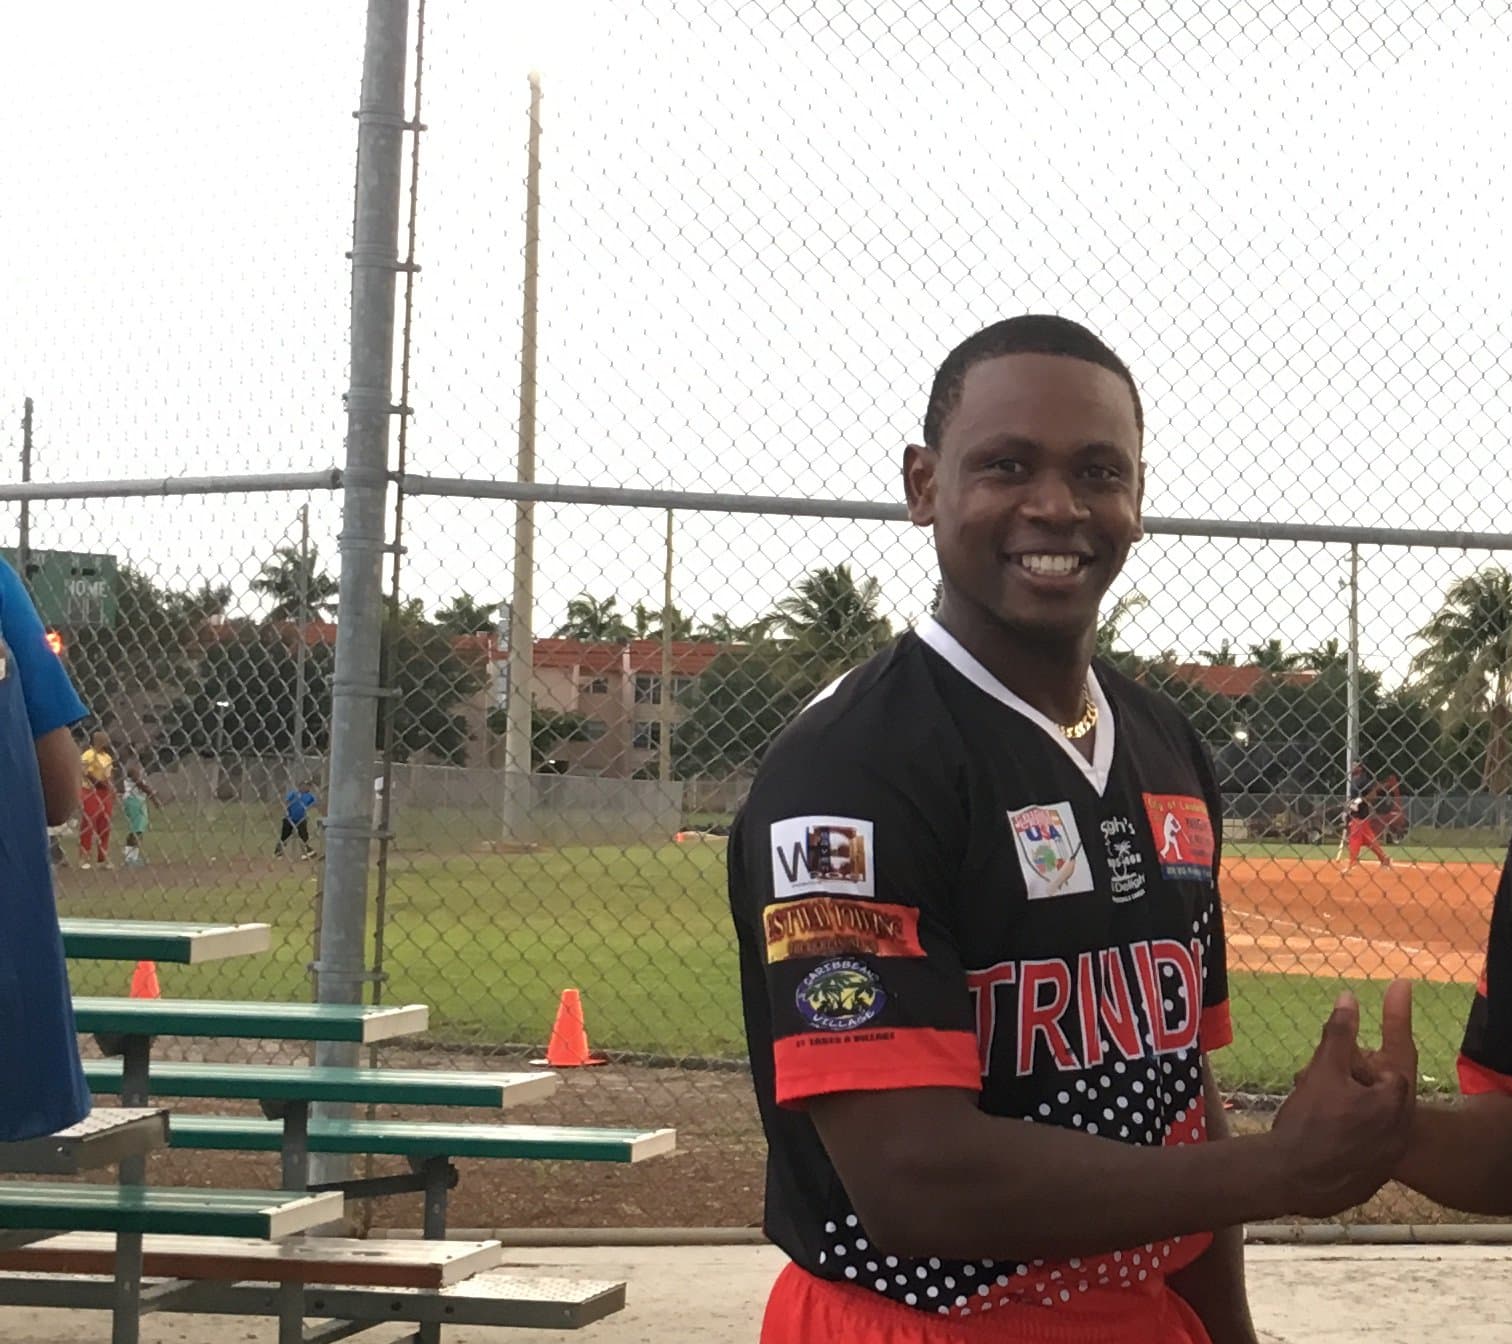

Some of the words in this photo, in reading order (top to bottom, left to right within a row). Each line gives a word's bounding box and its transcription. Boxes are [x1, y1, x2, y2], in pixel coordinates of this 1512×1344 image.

[1025, 824, 1062, 842] USA
[803, 959, 880, 987] CARIBBEAN
[966, 938, 1203, 1077] TRINID
[812, 1010, 875, 1029] VILLAGE
